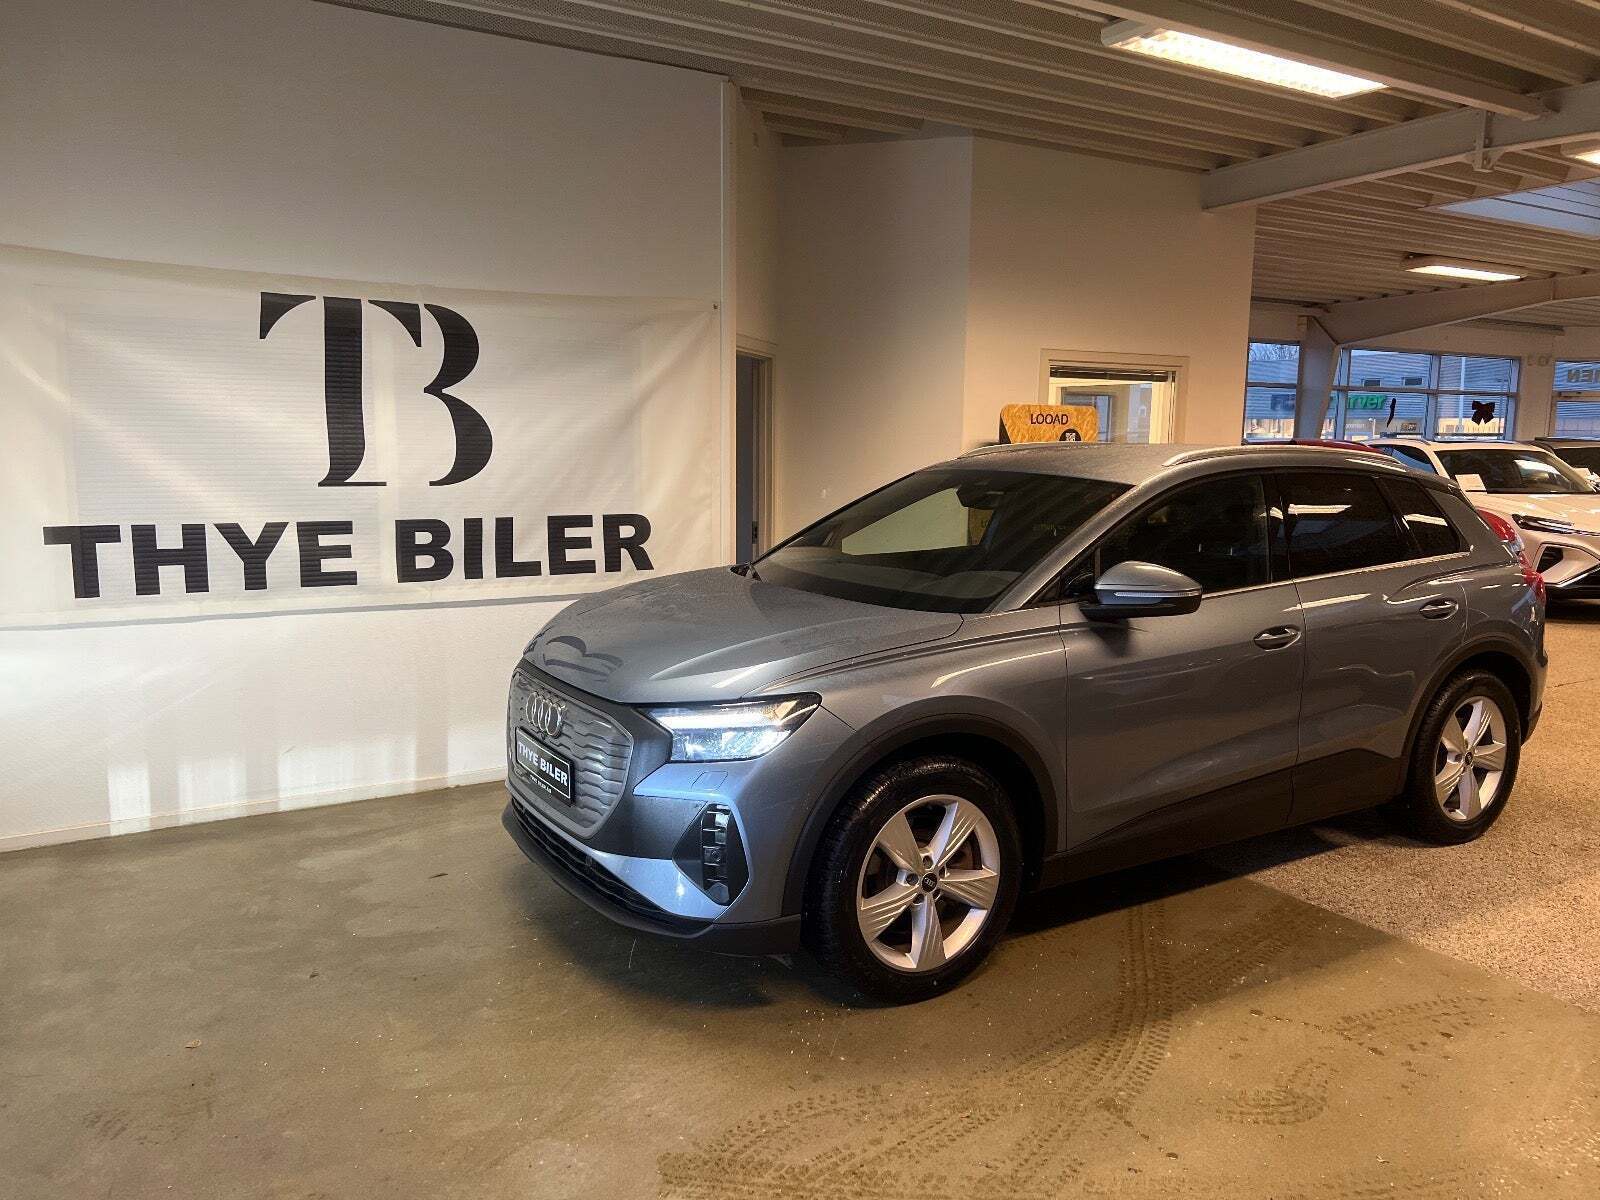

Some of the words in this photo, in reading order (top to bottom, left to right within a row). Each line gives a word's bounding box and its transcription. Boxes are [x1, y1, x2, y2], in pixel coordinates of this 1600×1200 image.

[1029, 413, 1069, 425] LOOAD
[43, 520, 358, 599] THYE
[394, 513, 655, 584] BILER
[518, 741, 539, 766] THYE
[540, 758, 568, 787] BILER
